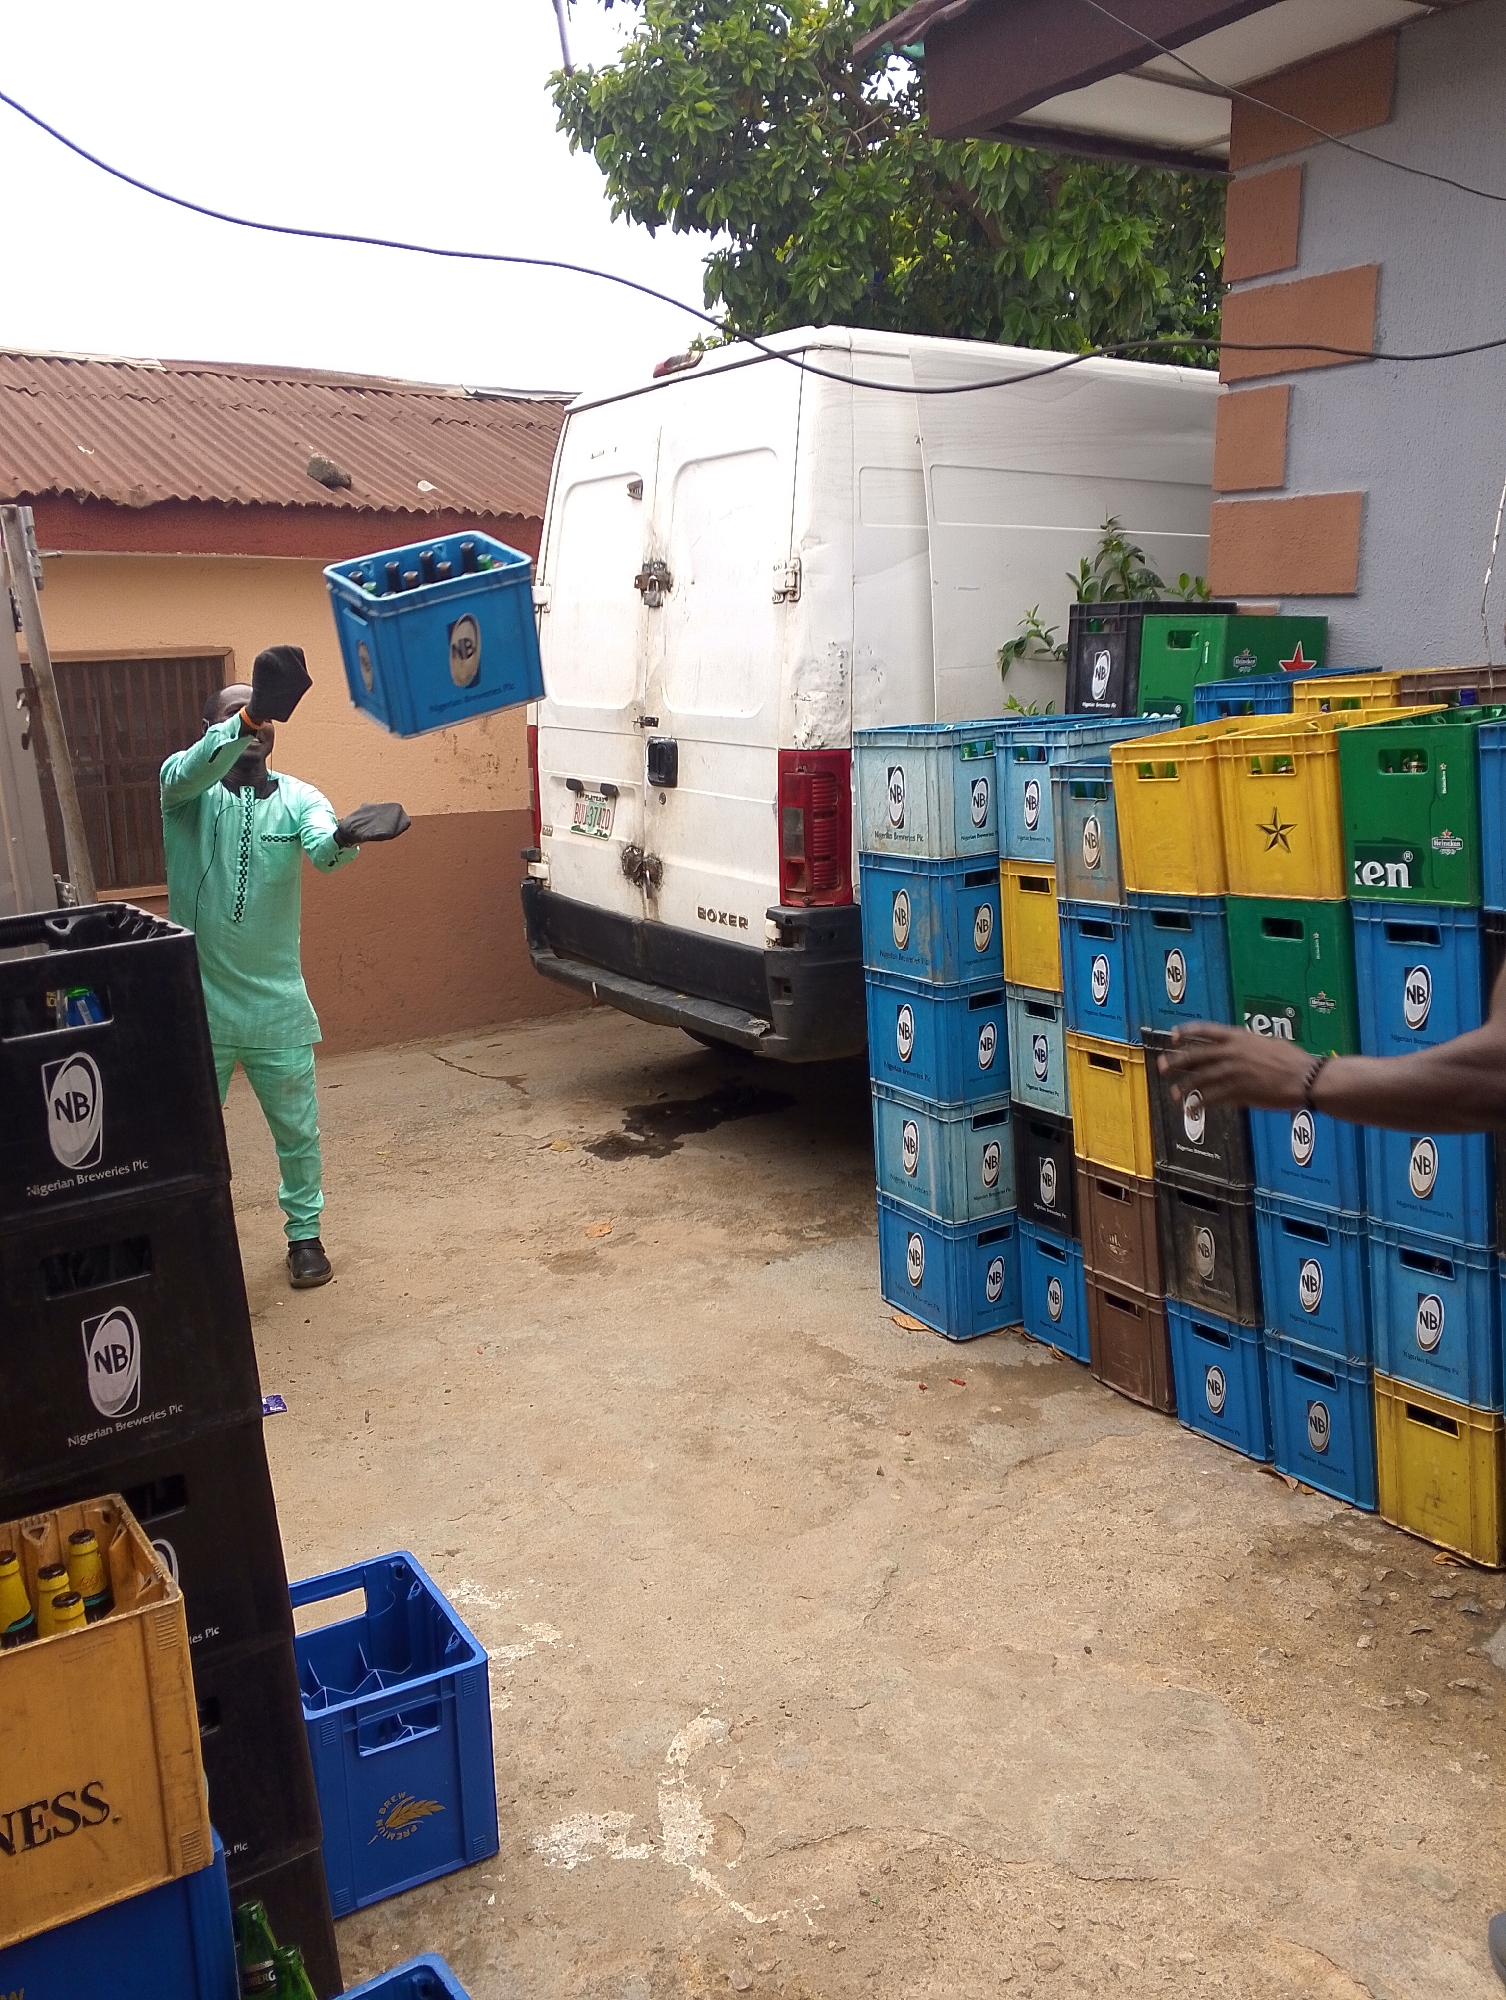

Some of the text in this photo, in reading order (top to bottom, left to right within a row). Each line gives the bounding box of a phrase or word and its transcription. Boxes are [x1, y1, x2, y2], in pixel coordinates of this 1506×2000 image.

[452, 637, 476, 660] NB
[1095, 666, 1107, 681] NB
[889, 784, 903, 804] NB
[973, 793, 986, 809] NB
[1026, 796, 1038, 811] NB
[874, 830, 893, 841] Nigerian
[893, 830, 915, 842] Breweries
[1085, 832, 1097, 849] NB
[697, 906, 749, 930] BOXER
[894, 908, 907, 926] NB
[977, 918, 990, 934] NB
[1093, 970, 1106, 986] NB
[1167, 966, 1182, 983] NB
[1406, 984, 1428, 1004] NB
[899, 1022, 911, 1039] NB
[980, 1036, 993, 1051] NB
[1035, 1046, 1047, 1063] NB
[54, 1091, 91, 1124] NB
[1293, 1126, 1309, 1144] NB
[904, 1136, 916, 1154] NB
[985, 1156, 998, 1170] NB
[1413, 1156, 1431, 1175] NB
[26, 1159, 149, 1197] Nigerian Breweries Plc
[1042, 1173, 1053, 1187] NB
[909, 1248, 921, 1267] NB
[1197, 1242, 1210, 1258] NB
[989, 1270, 1001, 1284] NB
[1302, 1274, 1317, 1293] NB
[1049, 1289, 1059, 1304] NB
[1419, 1311, 1438, 1331] NB
[94, 1343, 129, 1375] NB
[1208, 1379, 1222, 1396] NB
[68, 1403, 183, 1447] Nigerian Breweries Plc
[1309, 1415, 1325, 1434] NB
[205, 1625, 220, 1637] Plc
[376, 1791, 418, 1841] PREMIUM BREW
[233, 1842, 249, 1854] Plc
